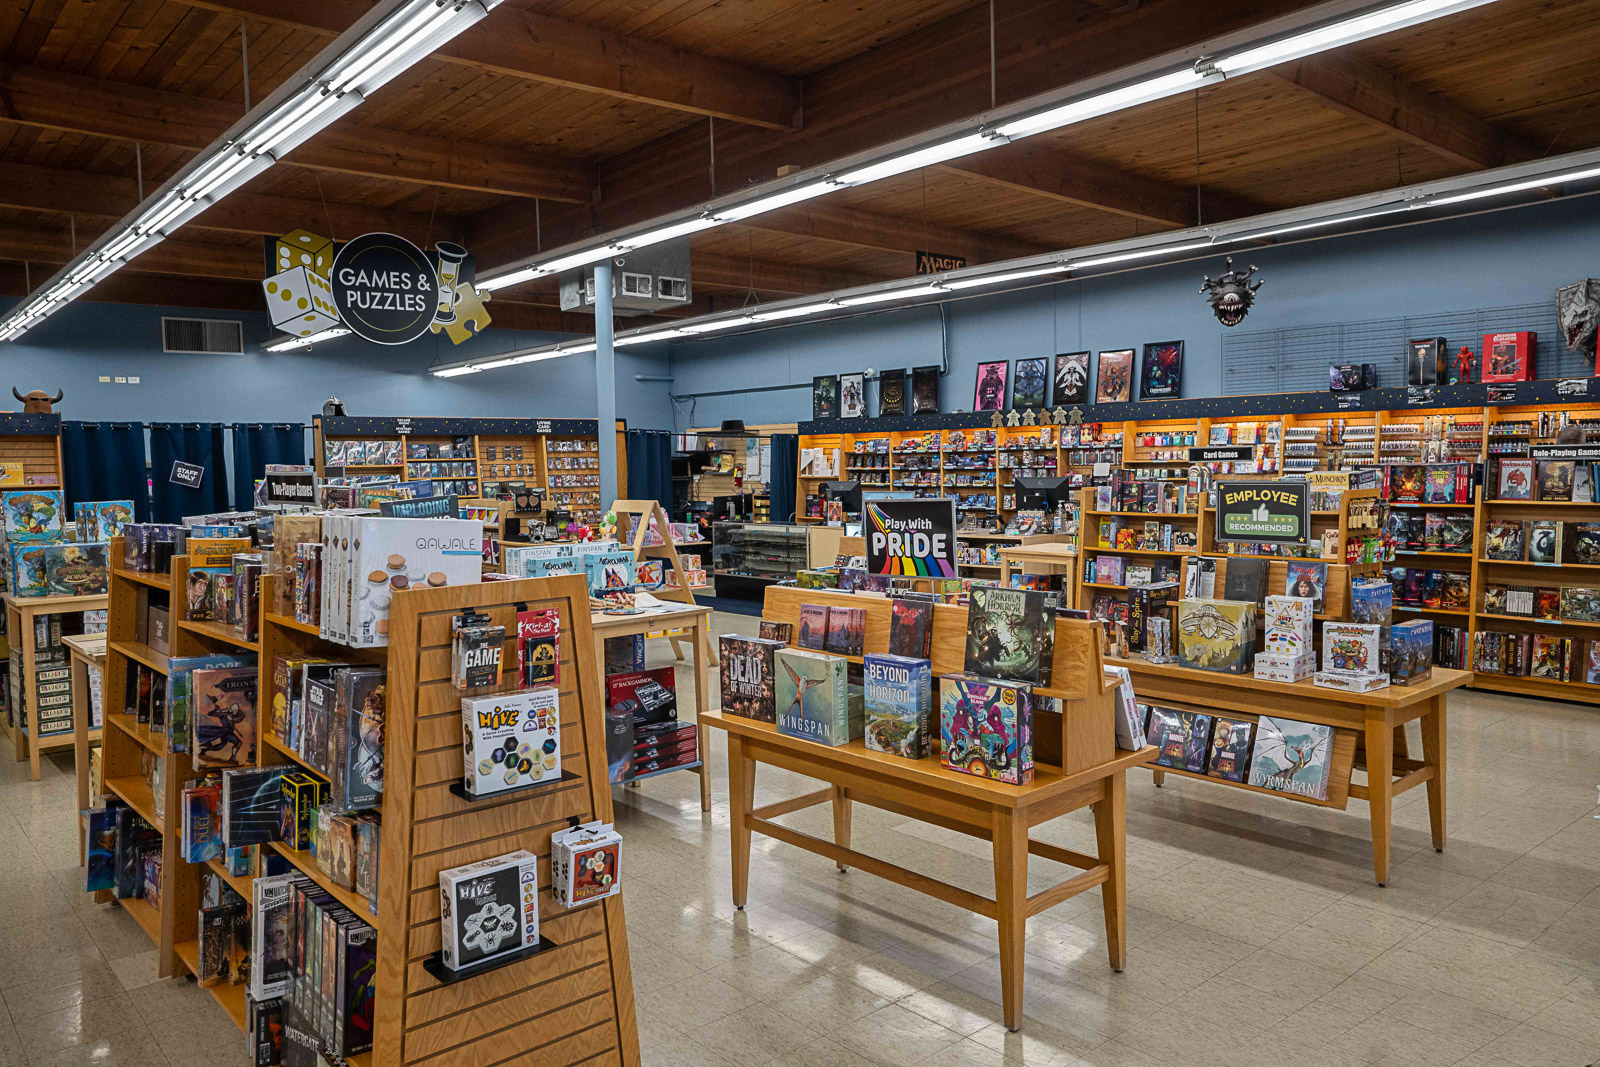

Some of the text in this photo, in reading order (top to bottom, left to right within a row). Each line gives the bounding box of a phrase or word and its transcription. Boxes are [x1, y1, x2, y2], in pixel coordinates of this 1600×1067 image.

[339, 268, 431, 291] GAMES &
[346, 290, 426, 312] PUZZLES
[1217, 451, 1239, 459] Games
[1533, 449, 1576, 457] Role-Playing
[177, 467, 199, 477] STAFF
[177, 473, 196, 481] ONLY
[1314, 474, 1347, 484] MUNCHKIN
[272, 482, 313, 498] Two-Player Games
[1225, 489, 1299, 506] EMPLOYEE
[392, 499, 450, 518] IMPLODING
[885, 518, 932, 531] Play With
[1229, 523, 1294, 532] RECOMMENDED
[416, 537, 476, 550] QAWALE
[577, 545, 603, 553] FINSPAN
[872, 532, 947, 558] PRIDE
[525, 549, 552, 557] FINSPAN
[989, 591, 1020, 602] ARKHAM
[987, 600, 1021, 612] HORROR
[1132, 597, 1143, 618] Spire
[205, 610, 212, 619] 2
[525, 621, 552, 633] Kiri-ai
[1130, 629, 1141, 644] Slay
[635, 634, 644, 664] ANOMIA
[465, 647, 501, 668] GAME
[729, 653, 762, 684] DEAD
[869, 663, 909, 684] BEYOND
[226, 678, 258, 689] IRONW
[618, 677, 653, 688] BACKGAMMON
[730, 680, 762, 697] OF WINTER
[869, 684, 910, 704] HORIZON
[778, 713, 830, 737] WINGSPAN
[1168, 733, 1184, 742] MARVEL
[1220, 751, 1236, 759] MARVEL
[1253, 771, 1315, 795] WYRMSPAN
[300, 793, 309, 821] Splendor
[199, 817, 209, 843] DUEL
[264, 885, 288, 897] UNMATCH
[264, 897, 288, 909] ADVENTUR
[350, 929, 376, 941] UNMATCHE
[284, 1024, 320, 1053] WATERGATE
